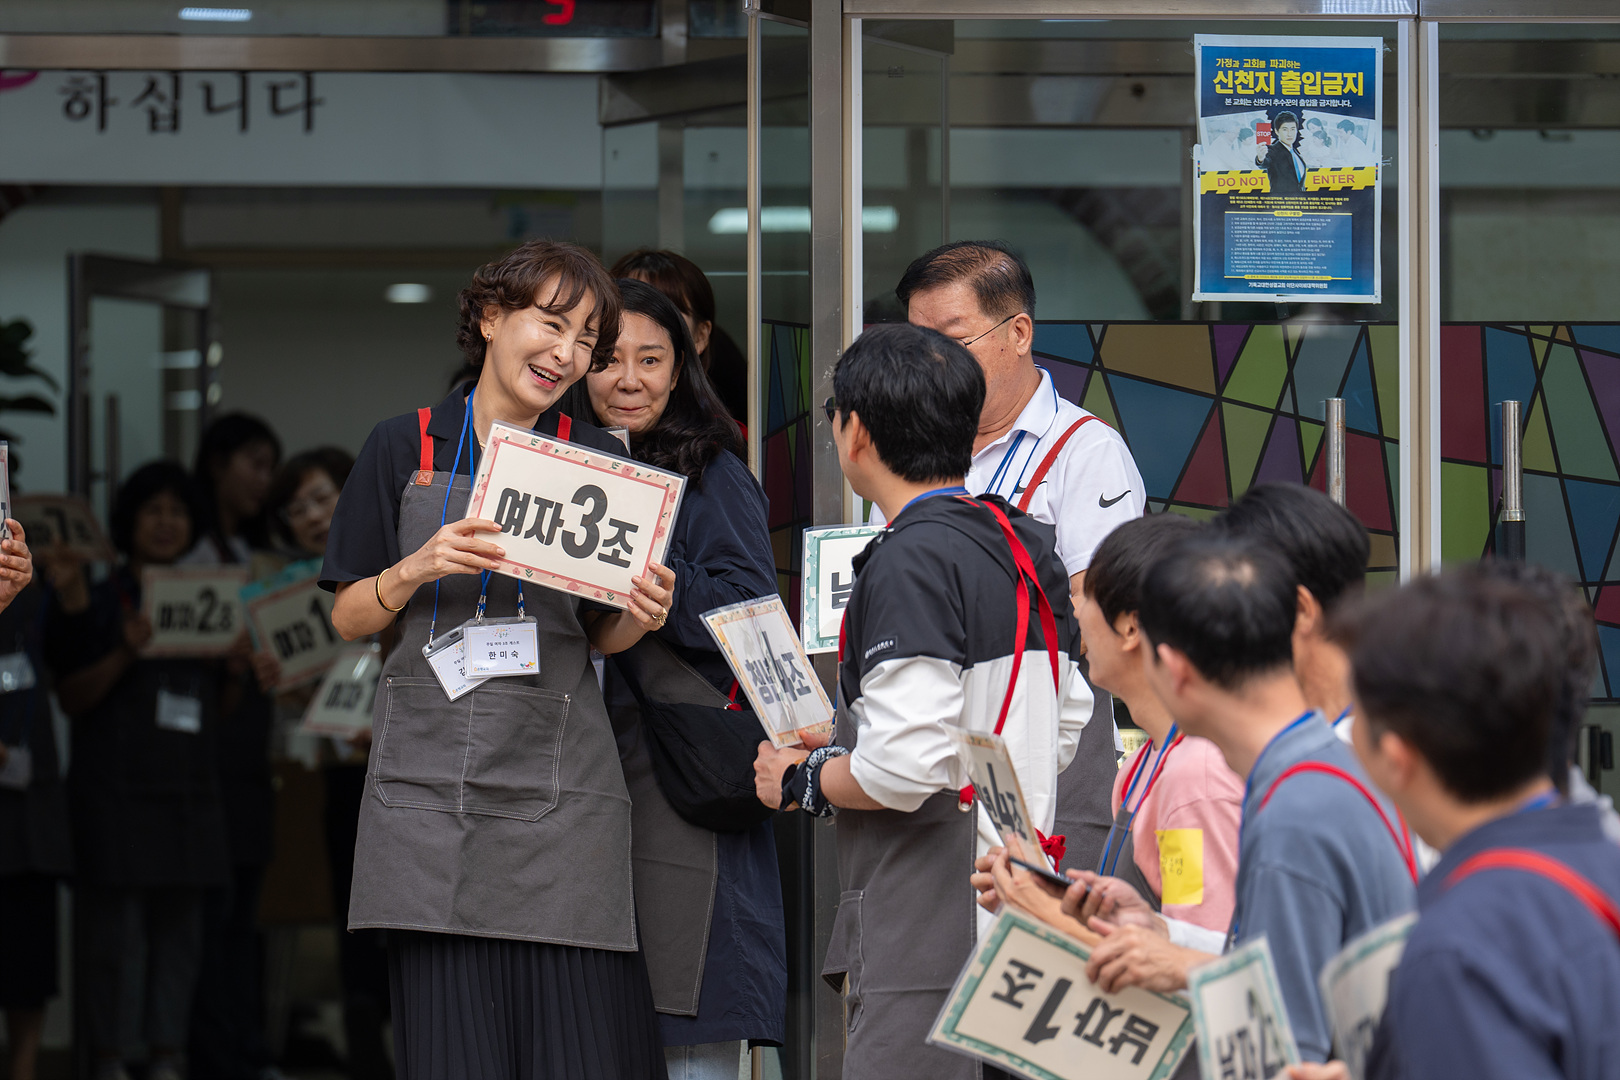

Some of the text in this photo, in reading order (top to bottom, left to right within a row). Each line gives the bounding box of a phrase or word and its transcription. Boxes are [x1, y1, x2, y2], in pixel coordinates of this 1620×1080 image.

[1215, 58, 1301, 69] 가정과 교회를 파괴하는
[1213, 70, 1364, 96] 신천지 출입금지
[59, 71, 325, 133] 하십니다
[1224, 98, 1232, 106] 본
[1233, 98, 1252, 106] 교회는
[1253, 98, 1272, 107] 신천지
[1272, 98, 1298, 107] 추수꾼의
[1299, 99, 1318, 107] 출입을
[1217, 174, 1355, 187] DO NOT ENTER
[493, 484, 639, 568] 여자3조
[990, 958, 1160, 1066] 남자1조
